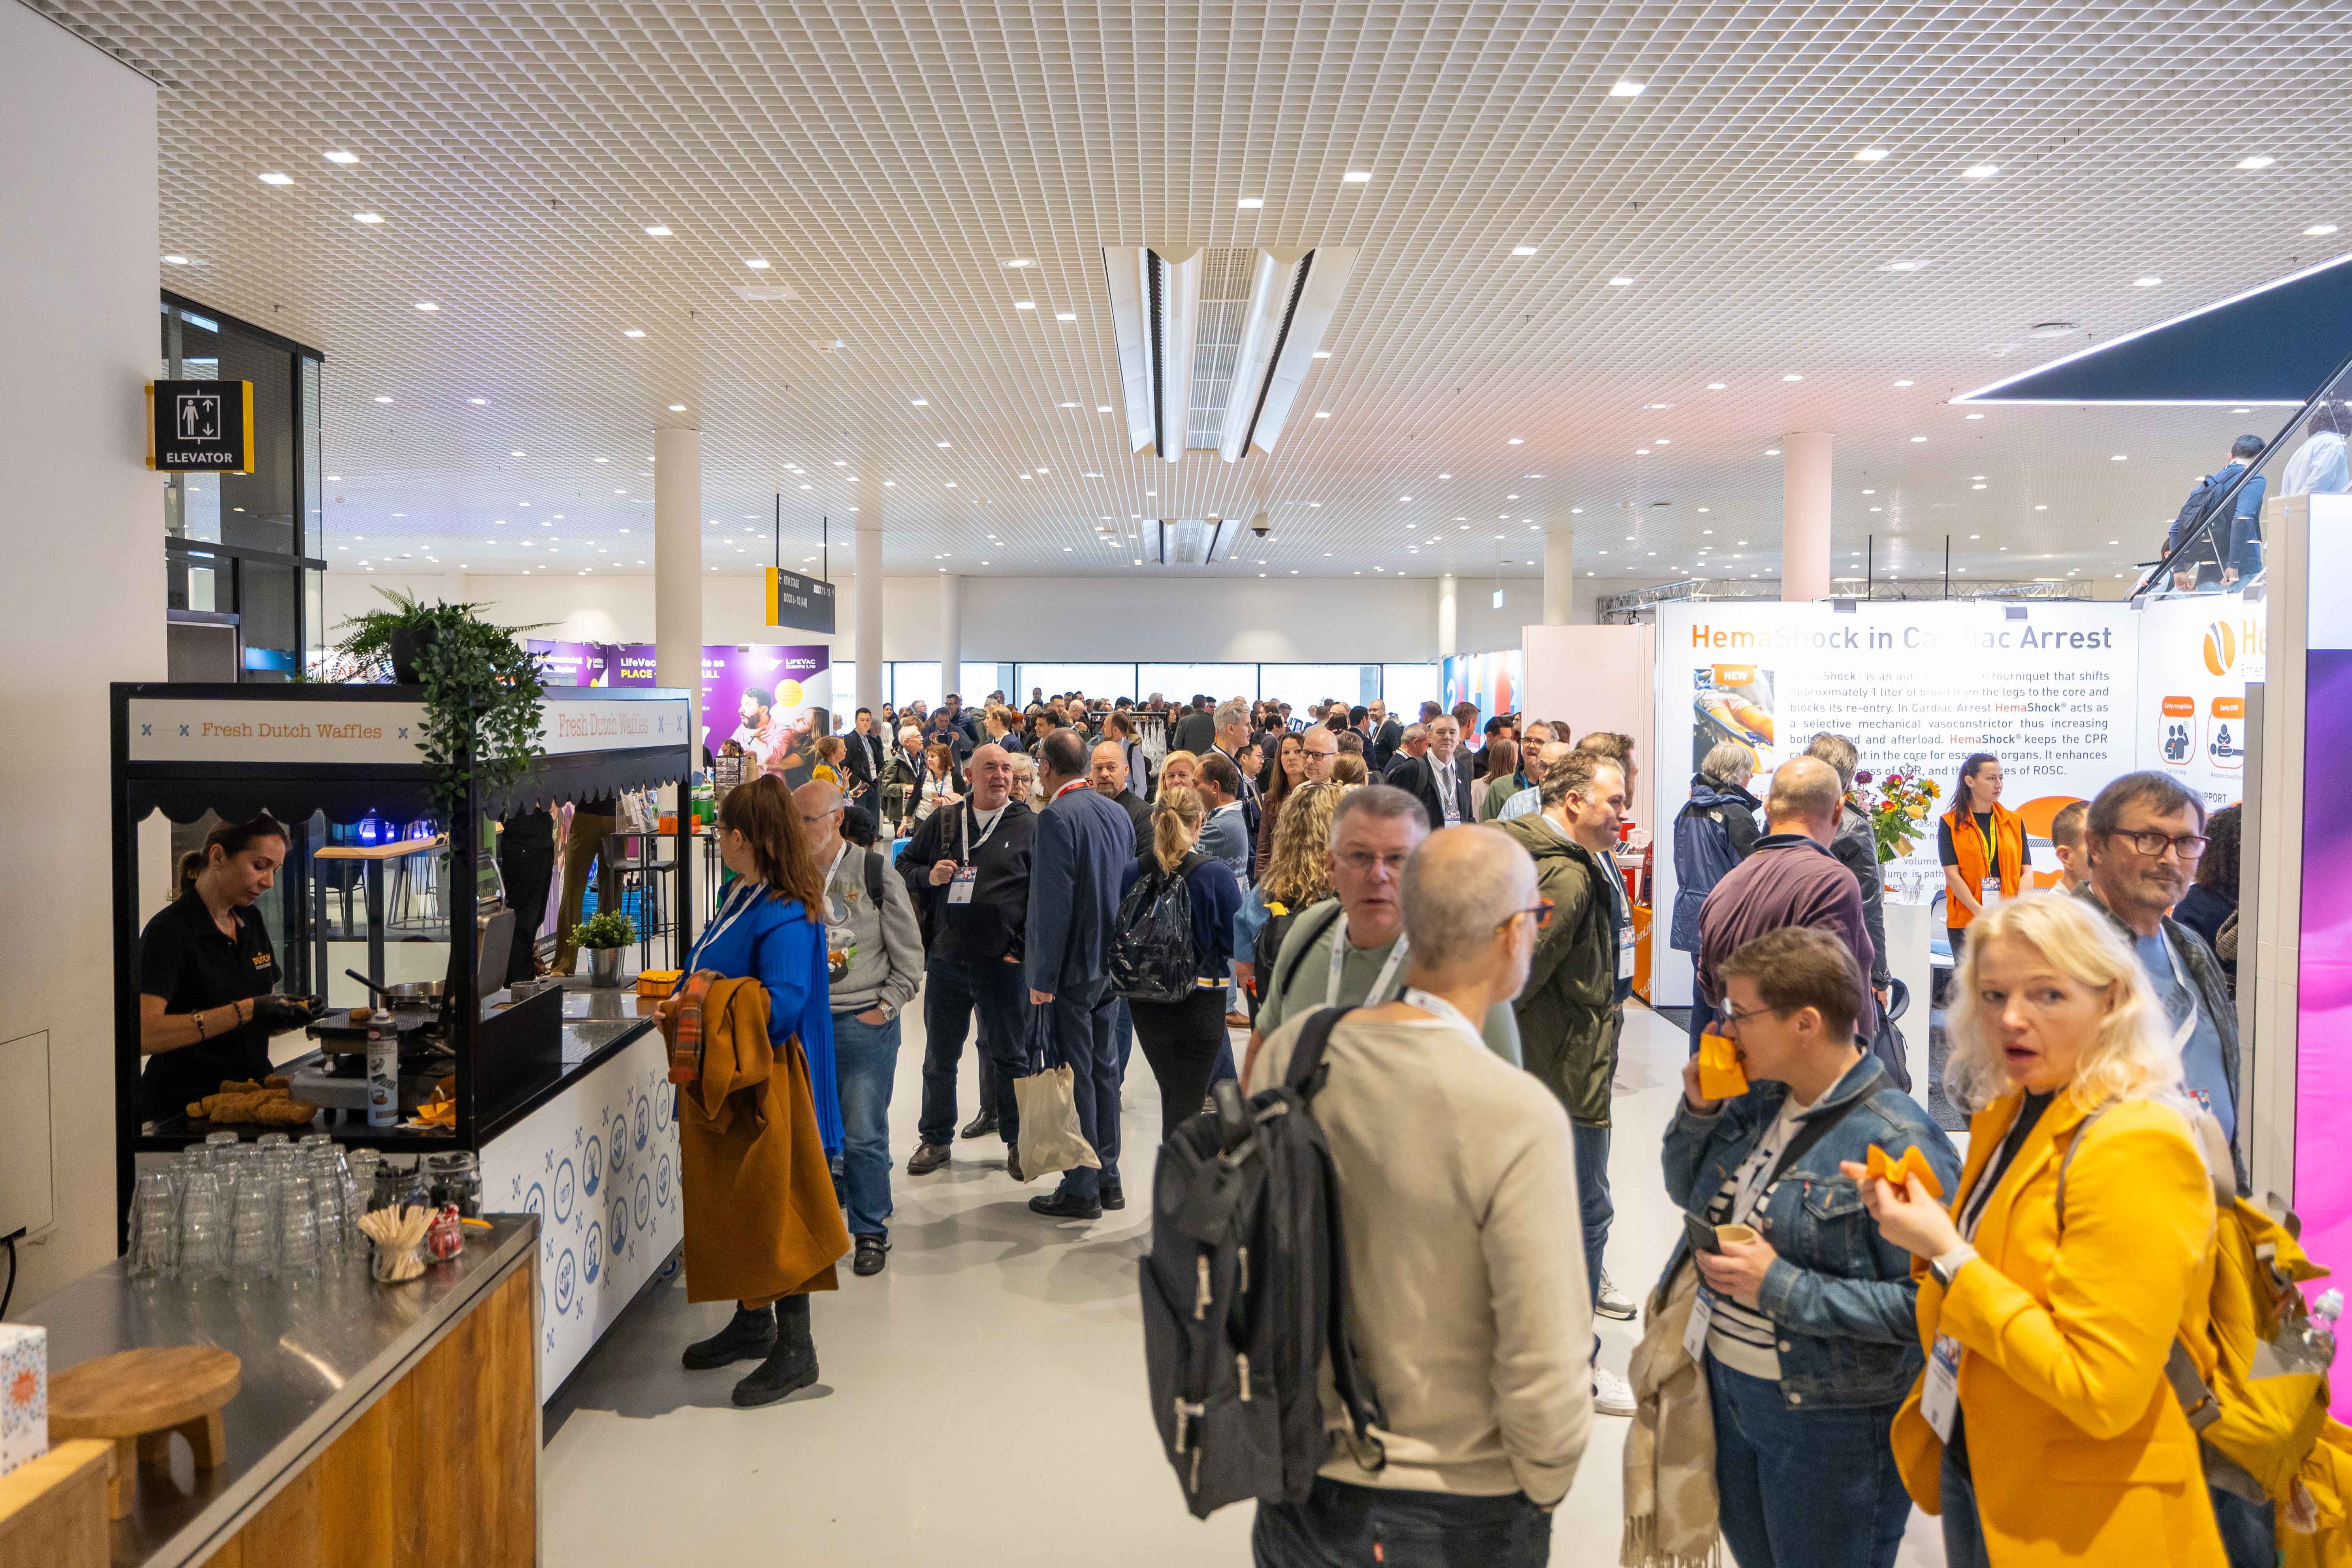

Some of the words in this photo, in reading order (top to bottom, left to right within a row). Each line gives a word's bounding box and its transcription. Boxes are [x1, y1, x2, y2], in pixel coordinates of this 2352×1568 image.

[167, 453, 232, 463] ELEVATOR
[791, 577, 799, 589] STAGE
[814, 584, 822, 595] DOCK
[822, 587, 825, 596] 11
[784, 593, 793, 604] DOCK
[797, 596, 800, 606] 10
[1870, 627, 1892, 649] in
[1904, 627, 2010, 649] Caiac
[2020, 626, 2111, 649] Arrest
[621, 658, 656, 667] LifeVac
[621, 669, 653, 678] PLACE
[702, 670, 720, 679] ULL
[1724, 672, 1748, 680] NEW
[1993, 672, 2049, 683] tourniquet
[2054, 672, 2075, 680] that
[2079, 671, 2109, 680] shifts
[1791, 688, 1868, 698] approximately
[1872, 688, 1876, 696] 1
[1881, 687, 1903, 696] liter
[1907, 688, 1916, 696] of
[1983, 688, 1999, 696] the
[2003, 687, 2025, 698] legs
[2029, 688, 2038, 696] to
[2043, 687, 2059, 696] the
[2089, 687, 2108, 696] and
[1791, 702, 1825, 712] blocks
[1830, 703, 1842, 712] its
[1846, 703, 1893, 714] re-entry.
[1898, 703, 1908, 712] In
[1912, 703, 1953, 712] Cardiac
[1957, 703, 1991, 712] Arrest
[2070, 703, 2092, 712] acts
[558, 713, 588, 738] Fresh
[590, 712, 618, 736] Dutch
[619, 712, 649, 735] Waffles
[1804, 719, 1851, 728] selective
[1859, 719, 1921, 728] mechanical
[1928, 719, 2013, 728] vasoconstrictor
[2021, 719, 2044, 728] thus
[2052, 718, 2108, 730] increasing
[202, 723, 253, 737] Fresh
[258, 723, 311, 738] Dutch
[317, 724, 382, 739] Waffles
[1790, 734, 1811, 744] both
[1866, 735, 1885, 744] and
[1891, 735, 1944, 744] afterload.
[2025, 735, 2056, 745] keeps
[2062, 734, 2079, 744] the
[2085, 734, 2108, 744] CPR
[1871, 751, 1879, 759] in
[1883, 751, 1900, 759] the
[1930, 751, 1945, 759] for
[2002, 752, 2041, 761] organs.
[2045, 750, 2052, 759] It
[2056, 750, 2107, 759] enhances
[1885, 766, 1895, 776] of
[1928, 766, 1947, 775] and
[1952, 766, 1960, 775] th
[2020, 766, 2030, 775] of
[2034, 766, 2066, 775] ROSC.
